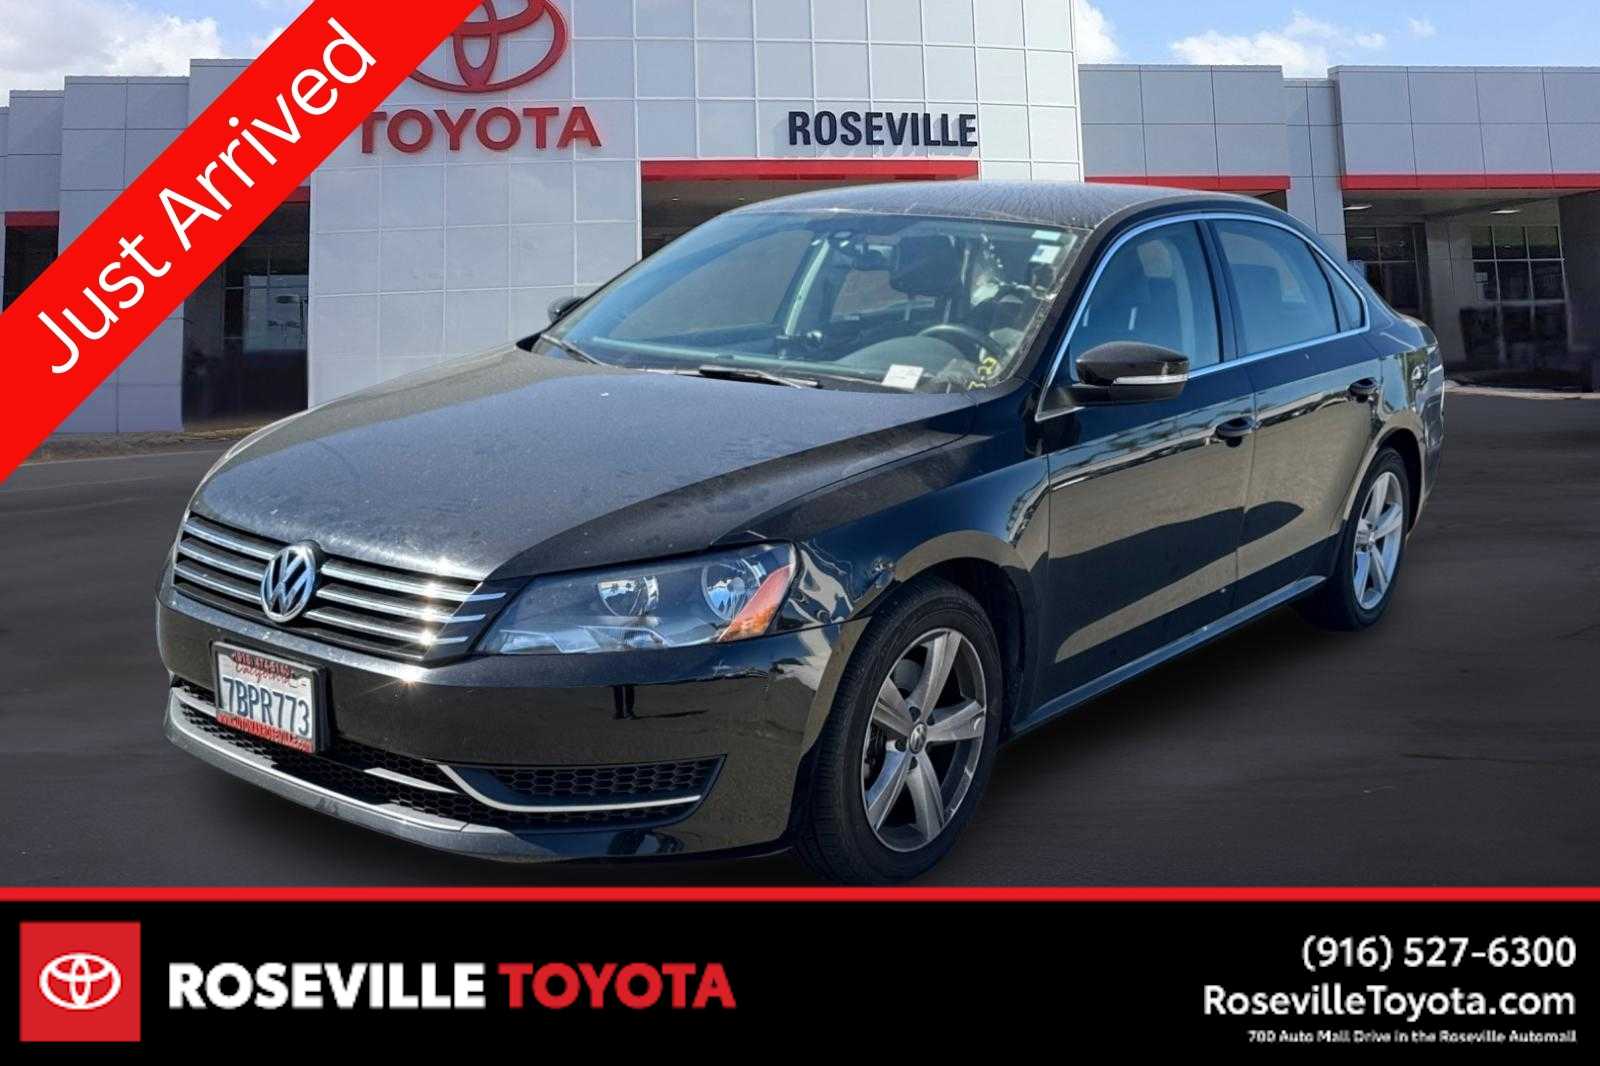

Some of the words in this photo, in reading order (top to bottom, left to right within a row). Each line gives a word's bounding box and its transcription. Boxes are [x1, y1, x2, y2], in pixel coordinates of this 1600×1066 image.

[361, 106, 602, 153] TOYOTA
[788, 110, 978, 147] ROSEVILLE
[222, 676, 309, 736] 7BPR773
